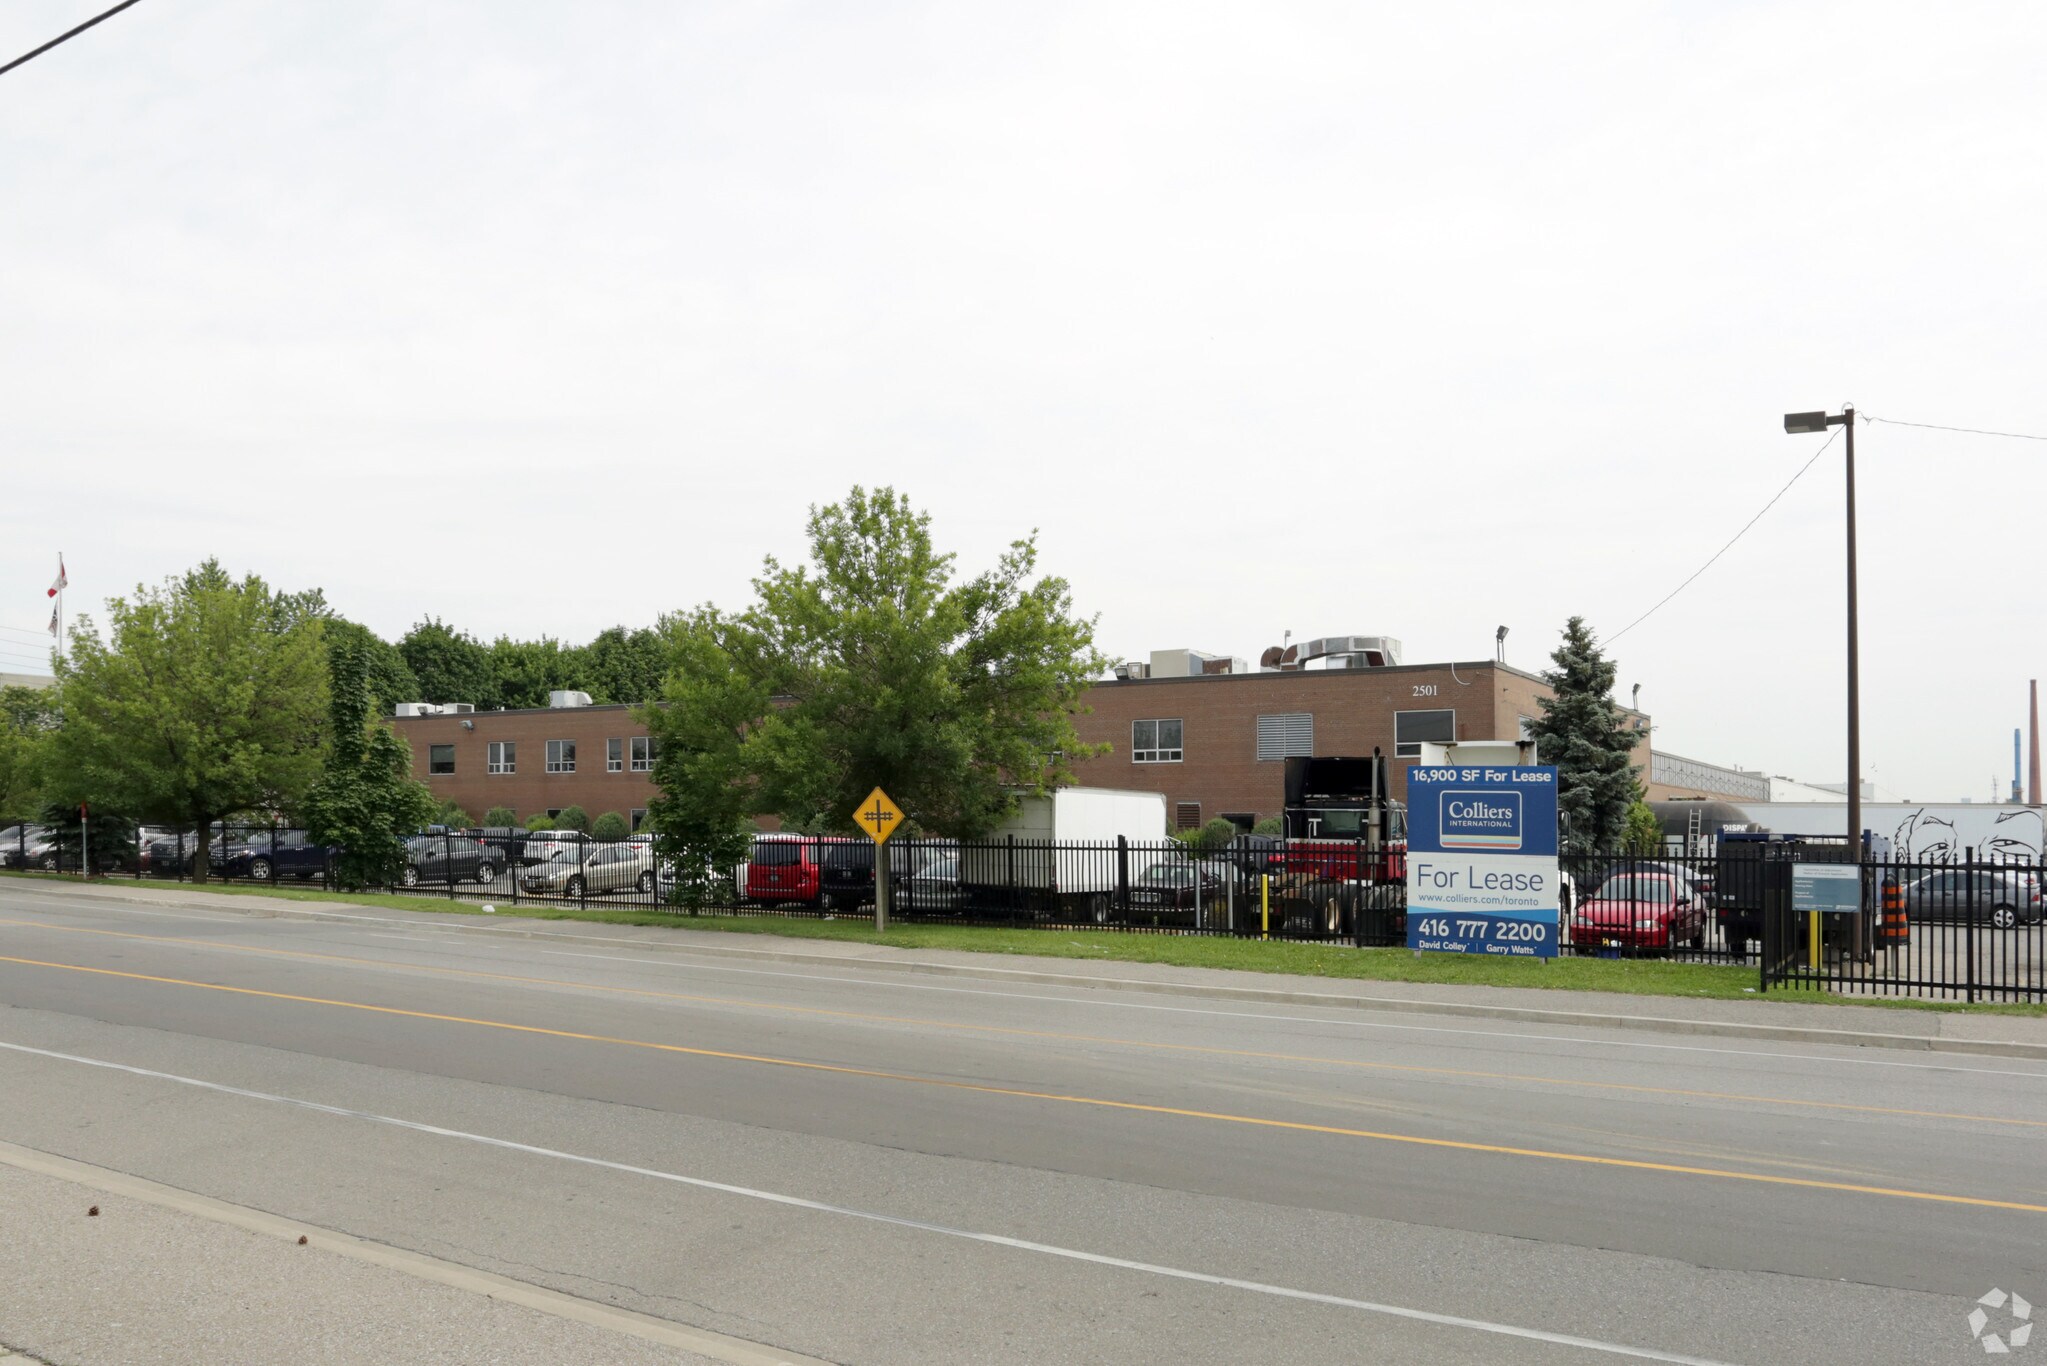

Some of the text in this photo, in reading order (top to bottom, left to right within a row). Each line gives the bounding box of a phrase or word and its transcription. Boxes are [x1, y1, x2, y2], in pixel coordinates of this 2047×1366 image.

[1412, 685, 1438, 697] 2501
[1413, 769, 1552, 783] 16,900 SF For Lease
[1448, 801, 1513, 819] Colliers
[1449, 820, 1512, 828] INTERNATIONAL
[1417, 863, 1544, 892] For Lease
[1418, 893, 1539, 906] www.colliers.com/toronto
[1418, 918, 1546, 942] 416 777 2200
[1419, 940, 1535, 955] David Colley Garry Watts
